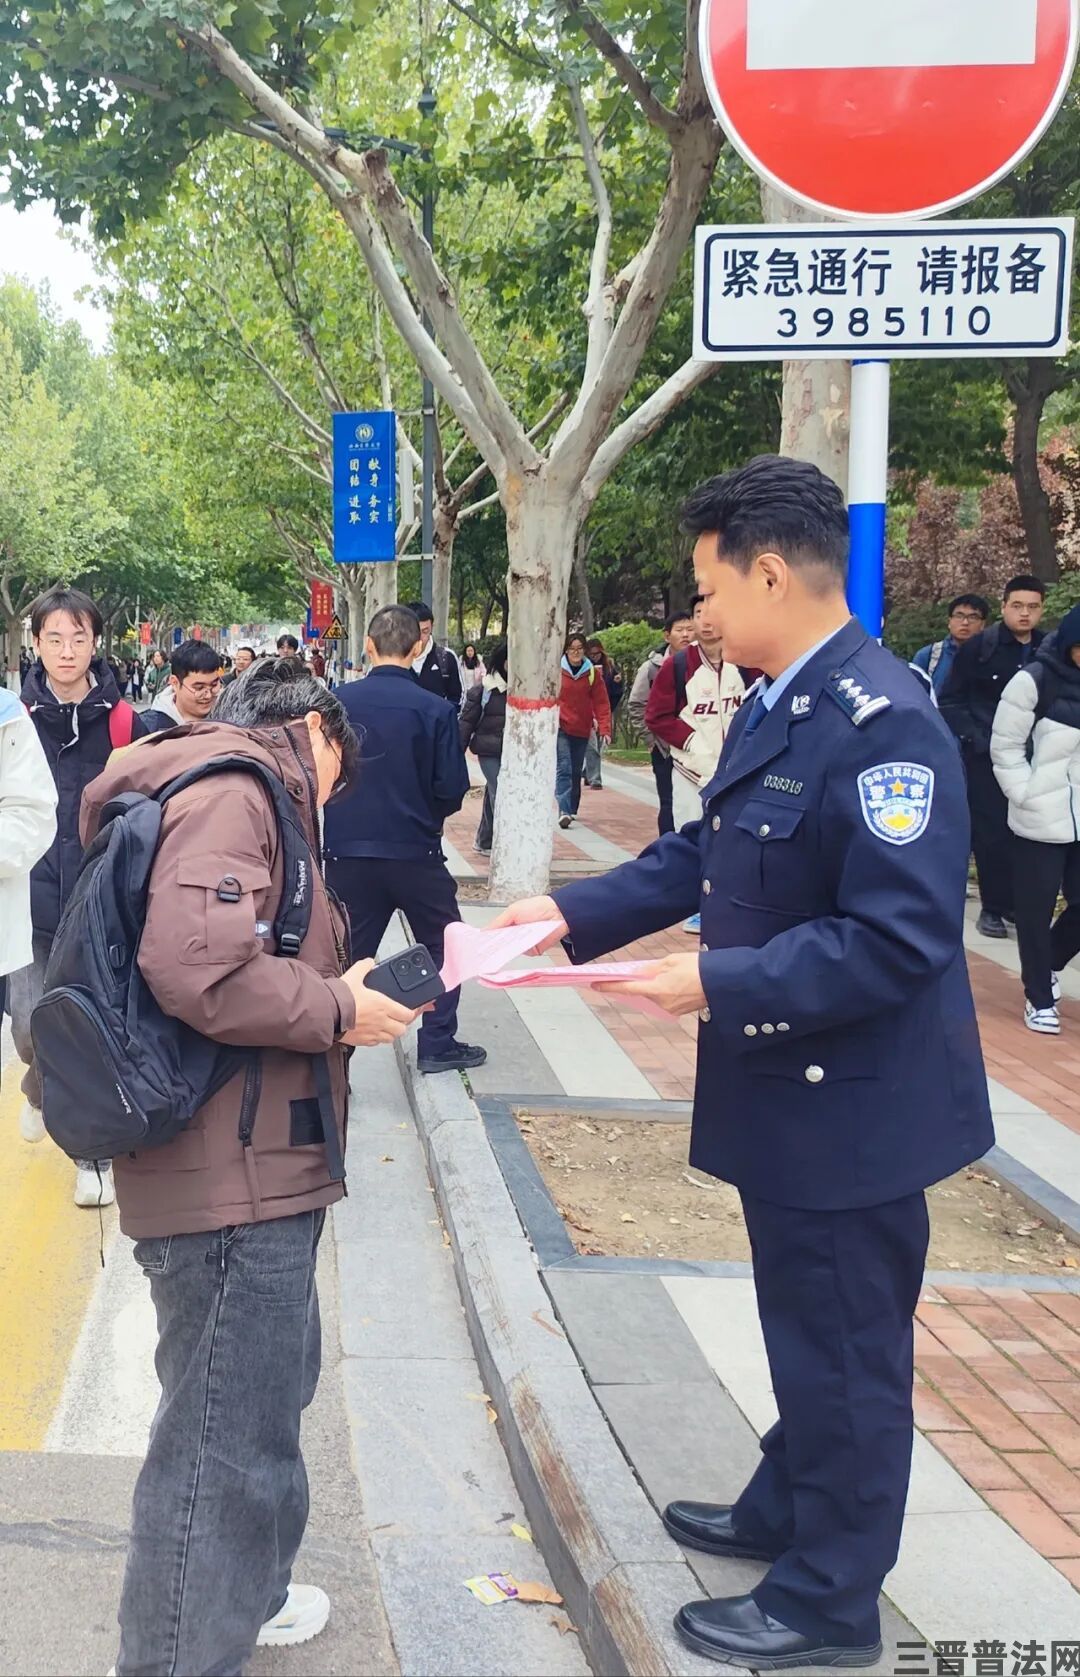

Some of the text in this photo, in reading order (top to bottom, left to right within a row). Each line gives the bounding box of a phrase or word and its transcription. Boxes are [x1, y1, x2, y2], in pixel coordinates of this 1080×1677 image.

[722, 243, 1046, 298] 紧急通行 请报备
[777, 305, 991, 338] 3985110
